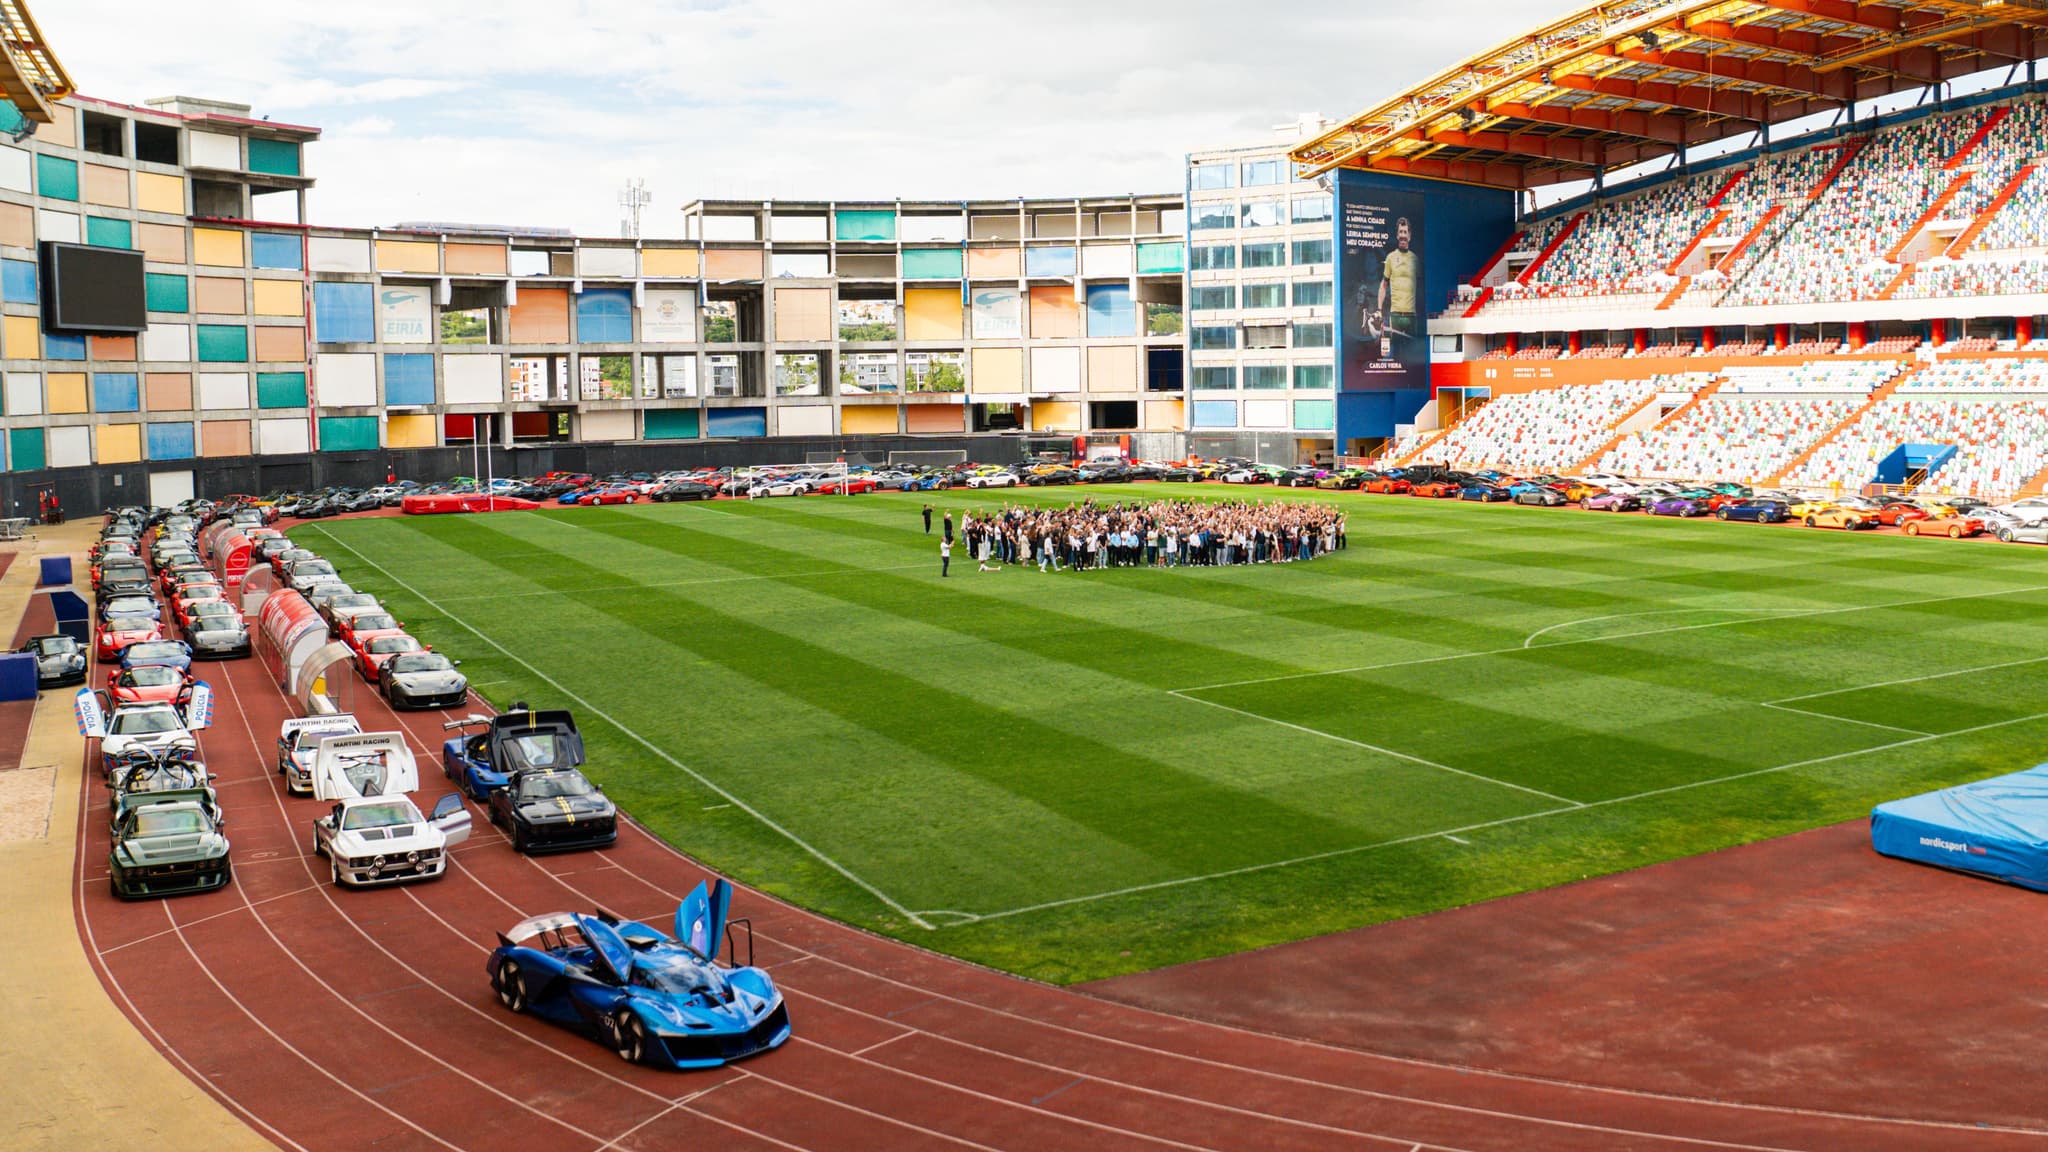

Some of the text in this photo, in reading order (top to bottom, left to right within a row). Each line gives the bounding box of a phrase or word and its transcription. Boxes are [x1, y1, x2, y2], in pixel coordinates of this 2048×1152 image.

[1368, 217, 1385, 225] CIDADE
[1346, 230, 1361, 238] LEIRIA
[1362, 231, 1380, 239] SEMPRE
[323, 718, 349, 726] RACING
[333, 738, 391, 748] MARTINI RACING
[1920, 836, 1967, 853] nordicsport
